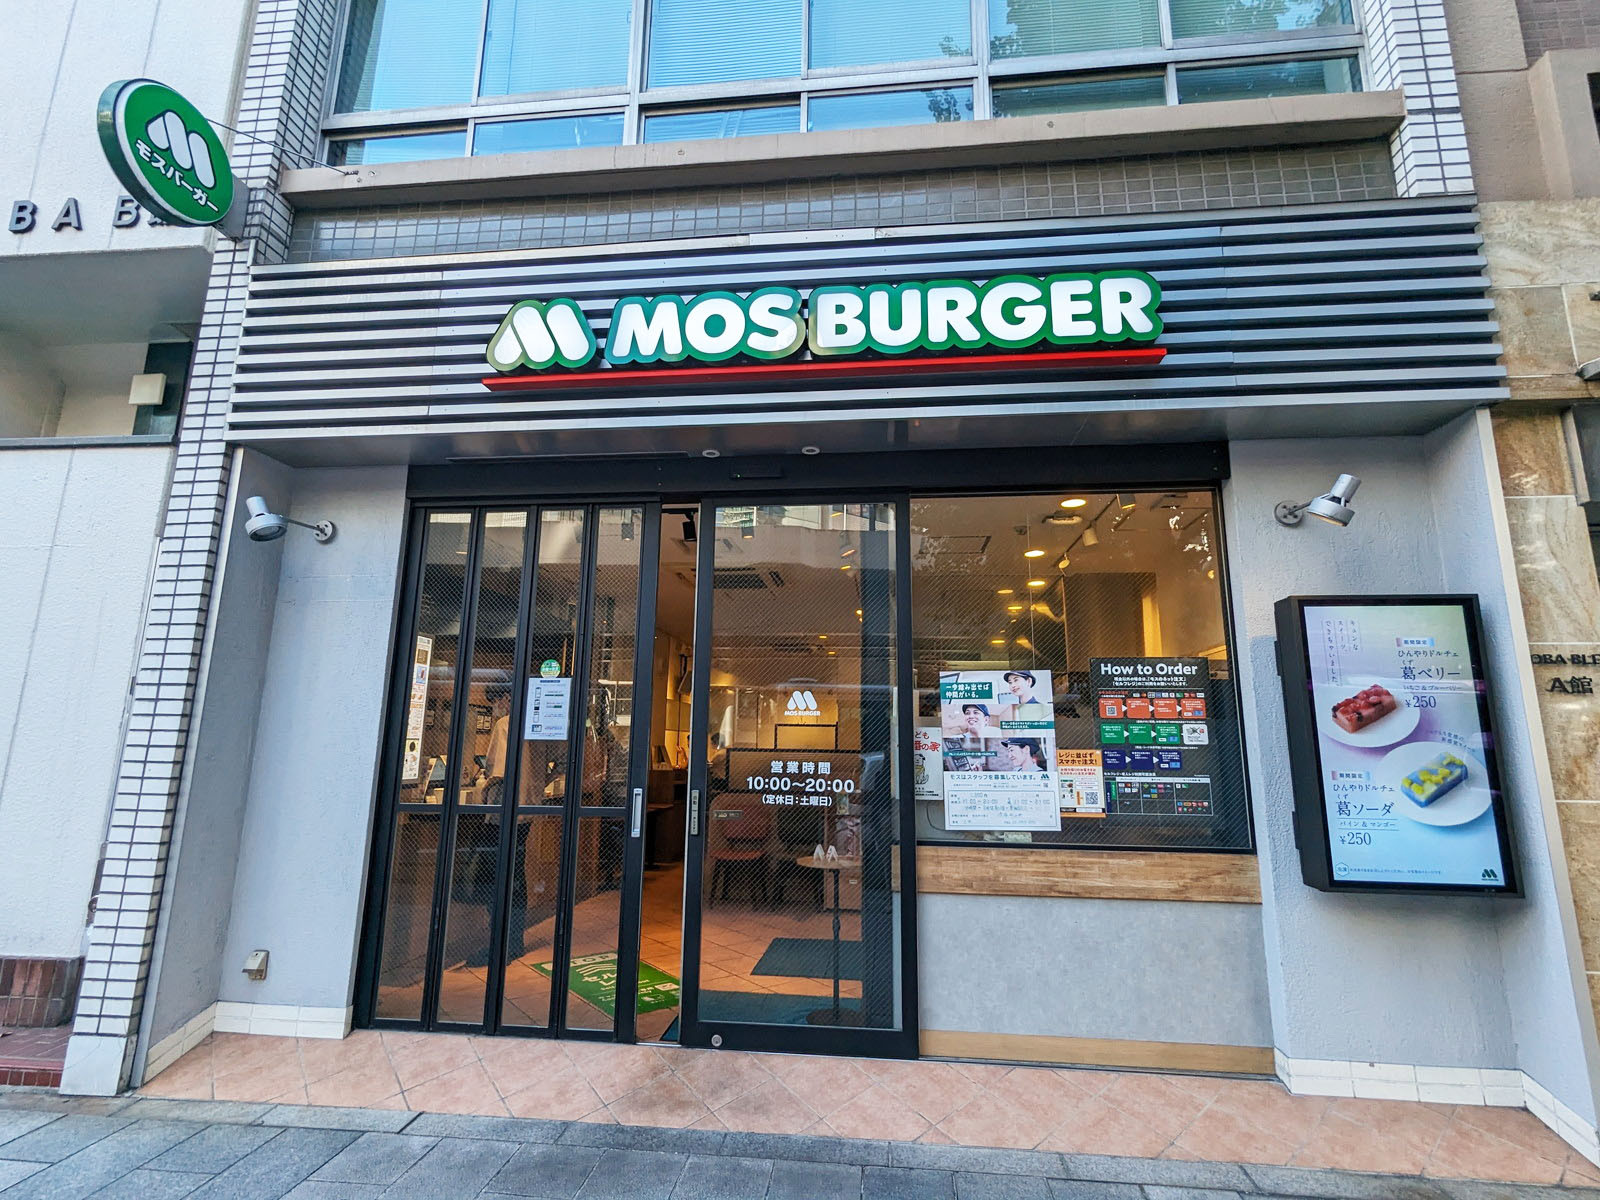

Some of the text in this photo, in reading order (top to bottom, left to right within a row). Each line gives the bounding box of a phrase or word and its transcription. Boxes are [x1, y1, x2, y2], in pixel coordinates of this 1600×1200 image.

[136, 139, 220, 213] モスバーガー
[610, 277, 1155, 358] MOS BURGER
[1398, 649, 1459, 657] ひんやりドルチェ
[1100, 662, 1198, 675] How to Order
[1400, 666, 1460, 681] 葛ベリー
[1545, 676, 1594, 695] A館
[1405, 695, 1437, 709] ¥250
[770, 760, 831, 775] 営業時間
[950, 773, 1037, 781] モスはスタッフを募集しています。
[1333, 783, 1395, 792] ひんやりドルチェ
[1336, 800, 1395, 816] 葛ソーダ
[1340, 832, 1372, 846] ¥250
